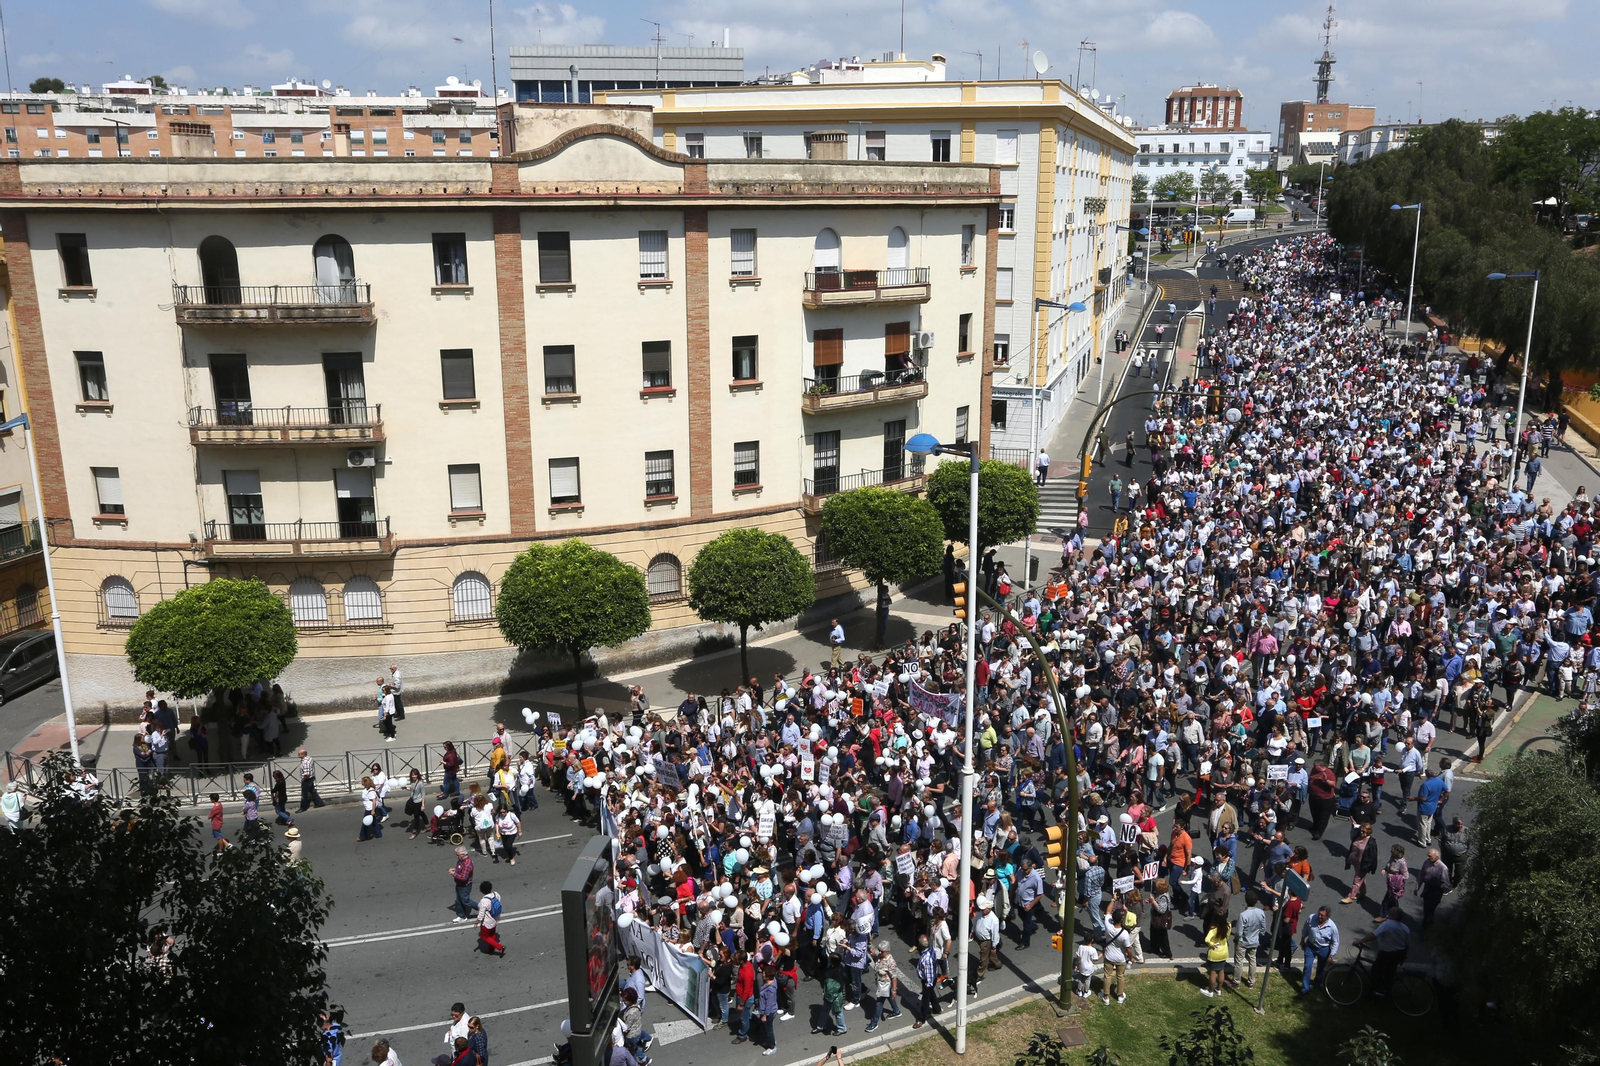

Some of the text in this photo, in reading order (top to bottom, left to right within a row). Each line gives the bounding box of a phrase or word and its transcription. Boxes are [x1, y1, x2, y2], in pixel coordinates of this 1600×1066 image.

[1471, 564, 1485, 576] NO
[903, 662, 918, 674] NO
[1120, 824, 1136, 842] NO
[1143, 862, 1158, 880] NO
